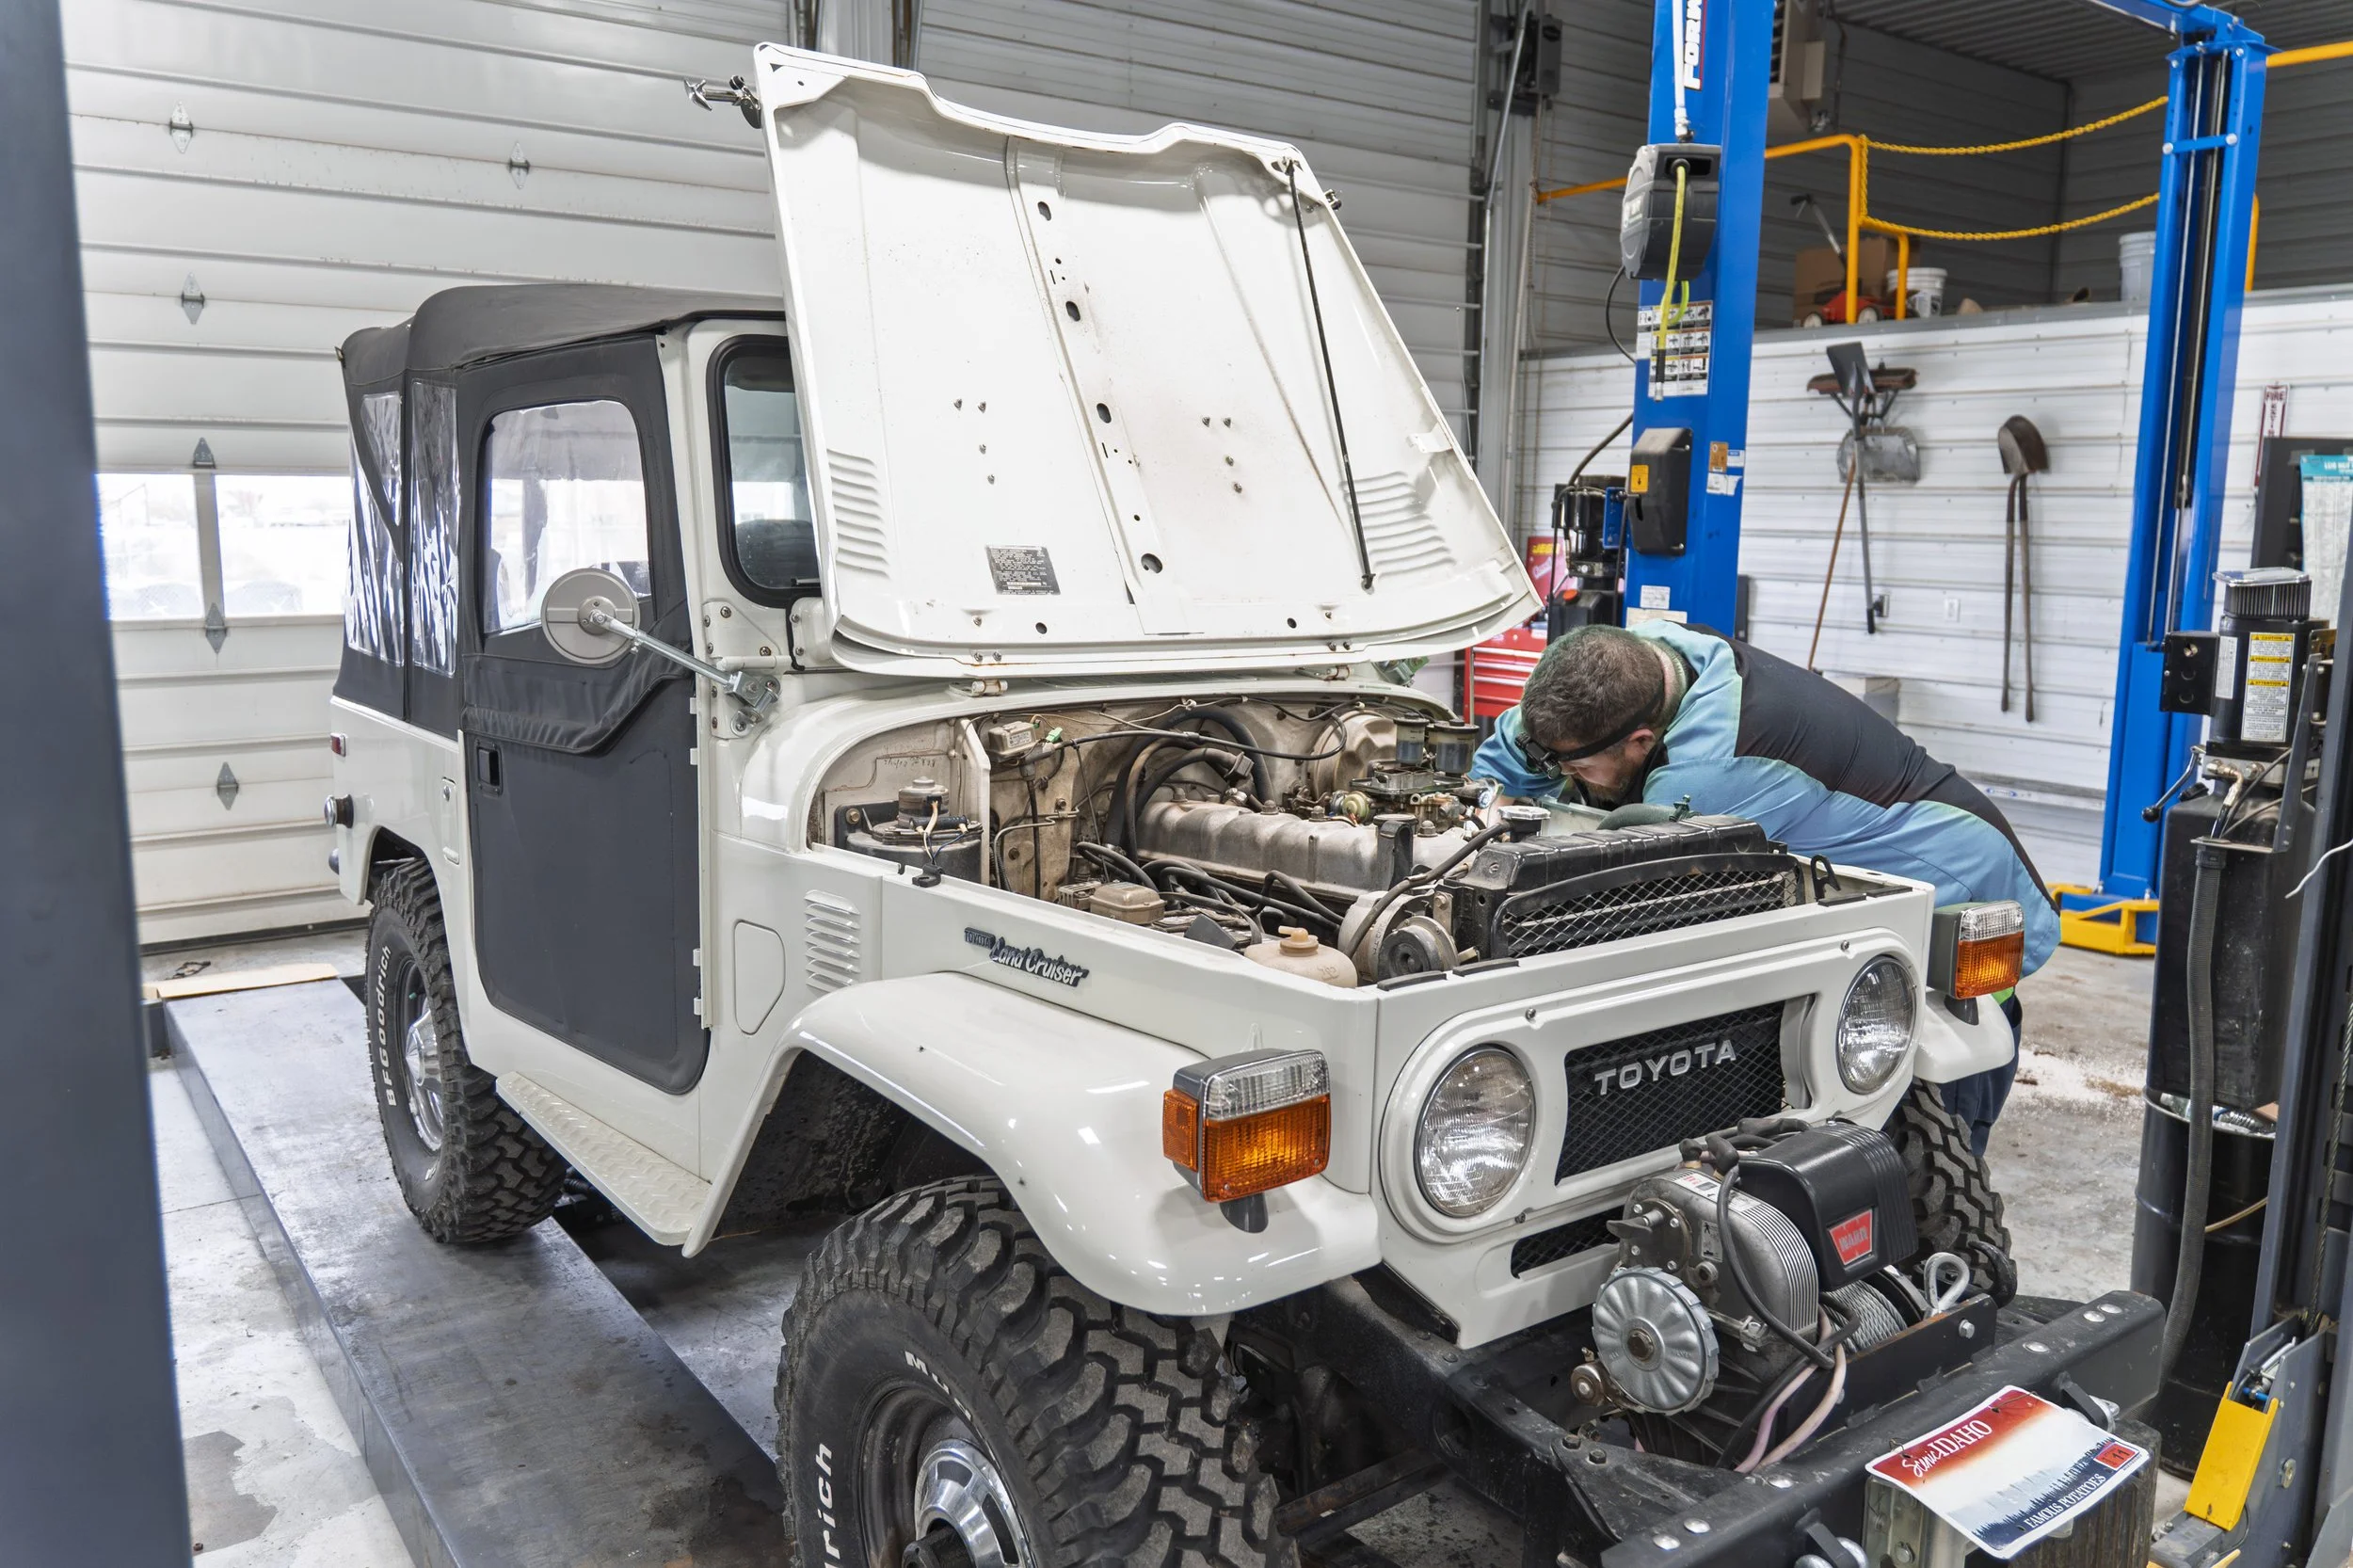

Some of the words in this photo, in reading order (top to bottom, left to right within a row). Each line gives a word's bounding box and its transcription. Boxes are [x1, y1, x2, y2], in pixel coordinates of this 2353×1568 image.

[964, 930, 992, 950] TOYOTA
[989, 939, 1025, 969] Land
[1025, 950, 1083, 985] Cruiser
[377, 945, 397, 1107] BFGoodrich
[1594, 1039, 1737, 1096] TOYOTA
[1838, 1225, 1867, 1252] WARN
[1935, 1419, 1993, 1458] IDAHO
[2112, 1449, 2130, 1460] 11
[2024, 1501, 2062, 1528] FAMOUS
[2060, 1473, 2106, 1512] POTATOES
